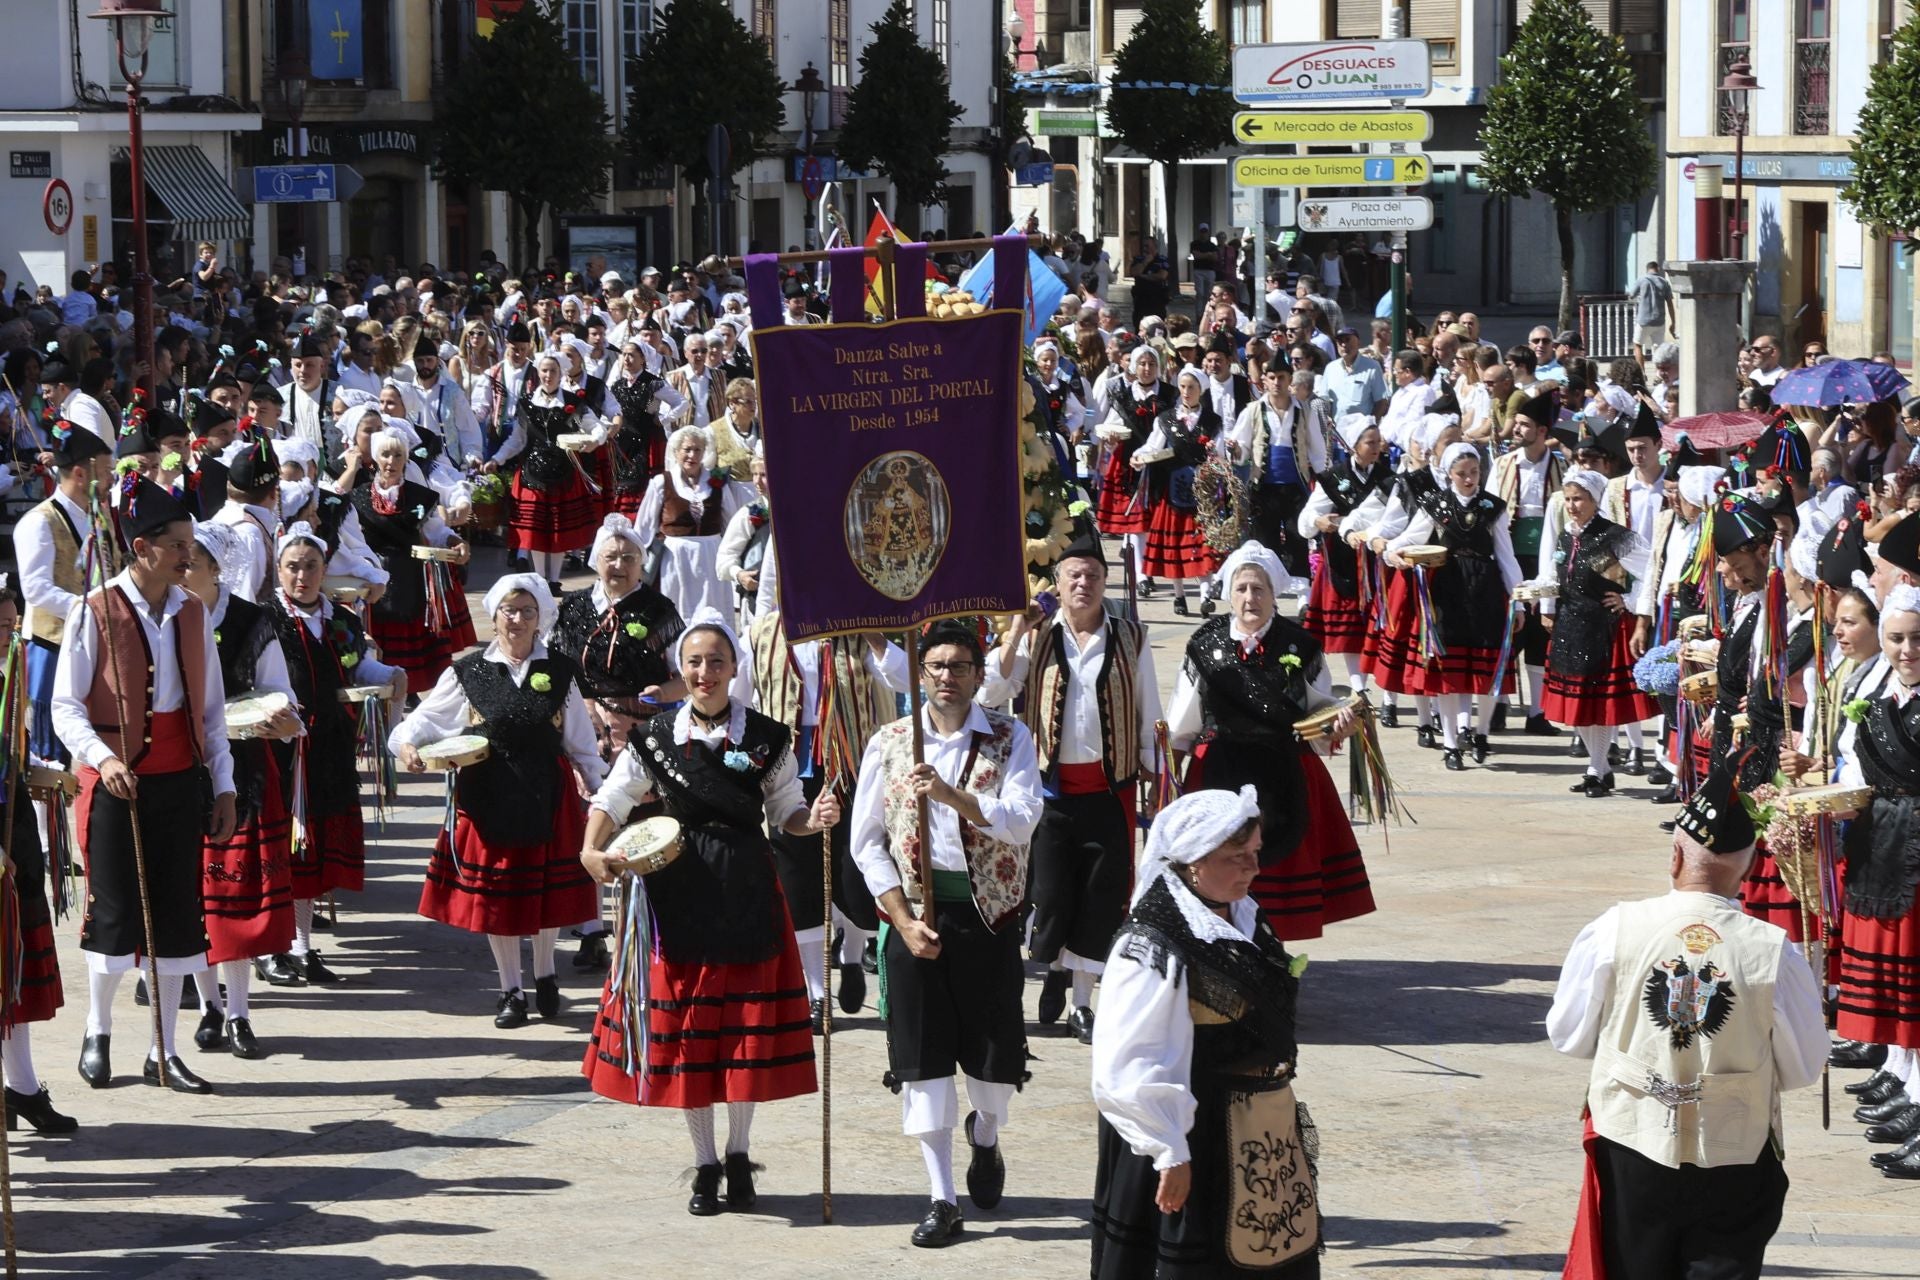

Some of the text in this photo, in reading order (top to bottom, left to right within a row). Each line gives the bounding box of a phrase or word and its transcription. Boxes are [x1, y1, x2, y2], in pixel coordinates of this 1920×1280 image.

[1303, 58, 1395, 71] DESGUACES
[1318, 71, 1377, 85] JUAN
[1273, 119, 1413, 132] Mercado de Abastos
[273, 134, 331, 157] FAACIA
[1240, 165, 1288, 176] Oficina
[1292, 165, 1311, 176] de
[1315, 164, 1362, 176] Turismo
[1757, 160, 1782, 176] LUCAS
[1351, 202, 1401, 211] Plaza del
[1338, 216, 1415, 228] Ayuntamiento
[835, 342, 943, 365] Danza Salve a
[852, 364, 933, 386] Ntra. Sra.
[792, 378, 995, 413] LA VIRGEN DEL PORTAL
[850, 407, 940, 432] Desde 1.954
[824, 614, 910, 633] Ayuntamiento
[911, 609, 921, 622] de
